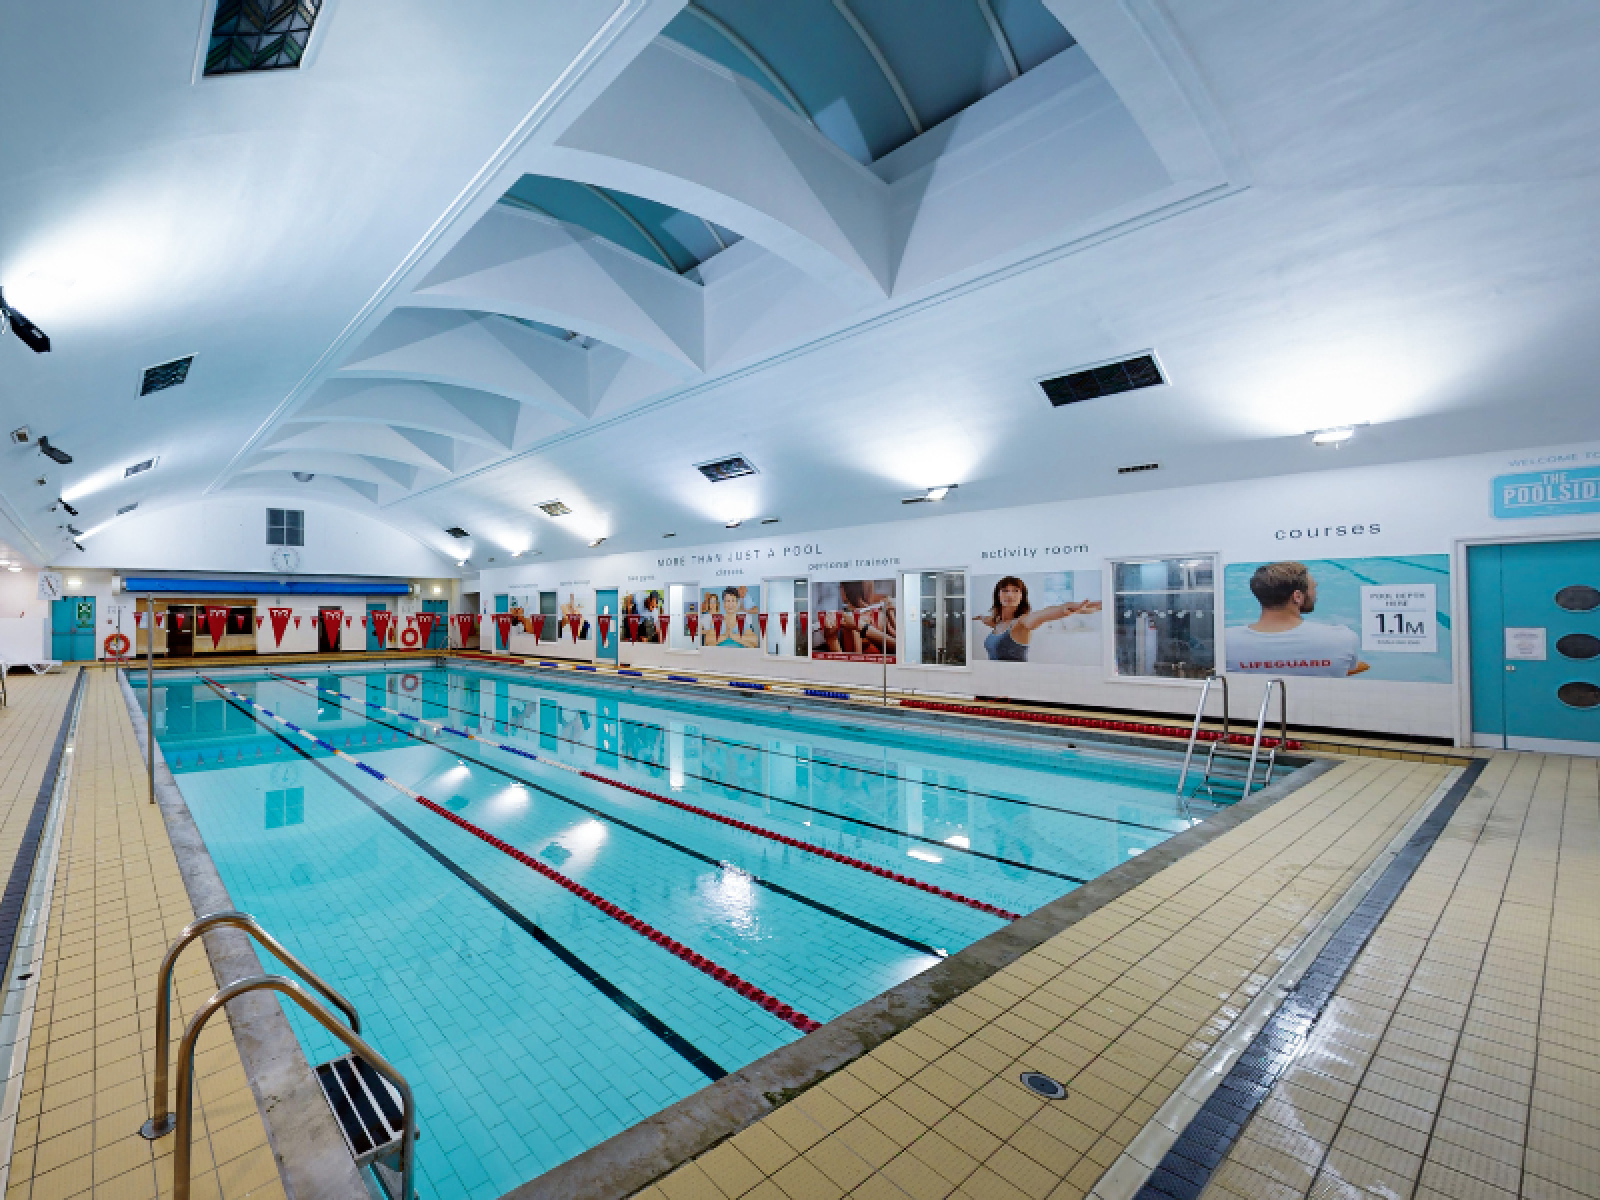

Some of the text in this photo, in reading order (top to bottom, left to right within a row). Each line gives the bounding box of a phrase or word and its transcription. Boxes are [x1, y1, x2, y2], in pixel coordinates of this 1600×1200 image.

[1508, 453, 1578, 467] WELCOME
[1542, 472, 1567, 485] THE
[1503, 481, 1600, 505] POOLSID
[1274, 523, 1381, 541] courses
[657, 543, 823, 567] MORE THAN JUST A POOL
[981, 543, 1089, 559] activity room
[808, 558, 900, 571] personal trainers
[1375, 613, 1425, 635] 1.1M
[1239, 659, 1332, 669] LIFEGUARD
